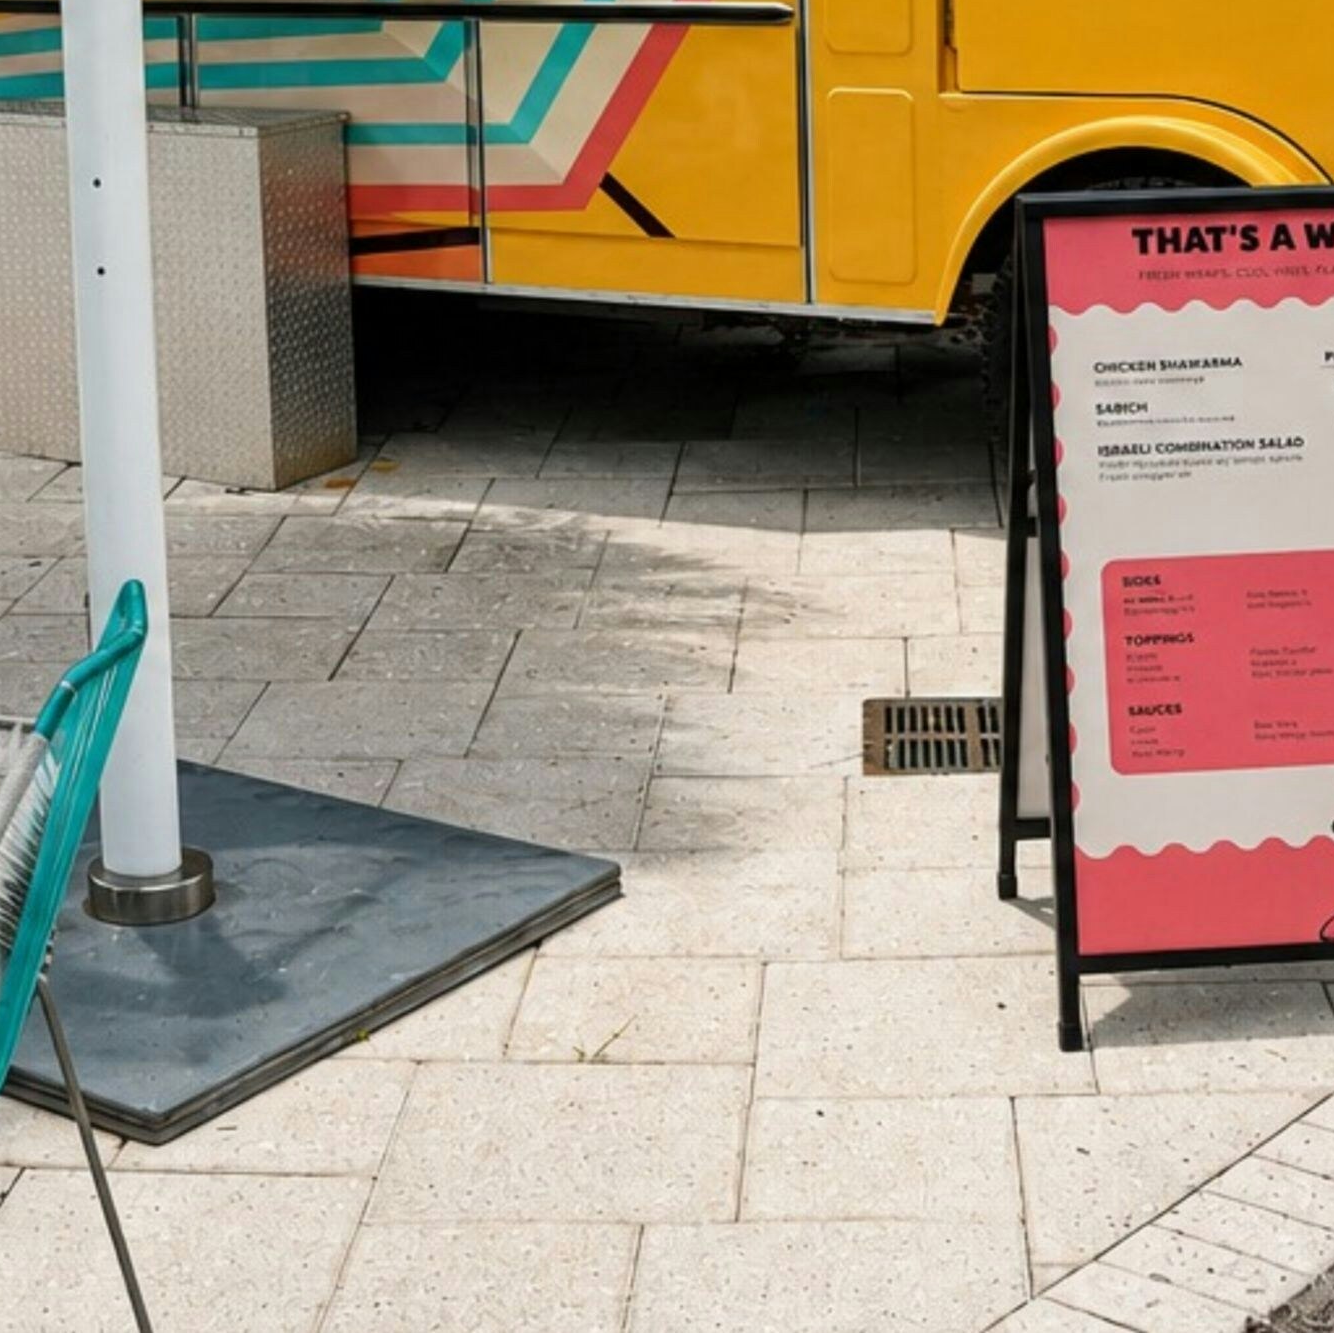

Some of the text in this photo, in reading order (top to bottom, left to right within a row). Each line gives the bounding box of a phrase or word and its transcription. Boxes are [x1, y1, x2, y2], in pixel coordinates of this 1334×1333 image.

[1132, 225, 1260, 255] THAT'S
[1270, 223, 1296, 251] A
[1094, 360, 1156, 374] CHICKEN
[1097, 436, 1305, 457] ISRAELI COMBINATION SALAD
[1122, 574, 1162, 588] SIDES
[1124, 631, 1195, 647] TOPPINGS
[1128, 703, 1183, 717] SAUCES
